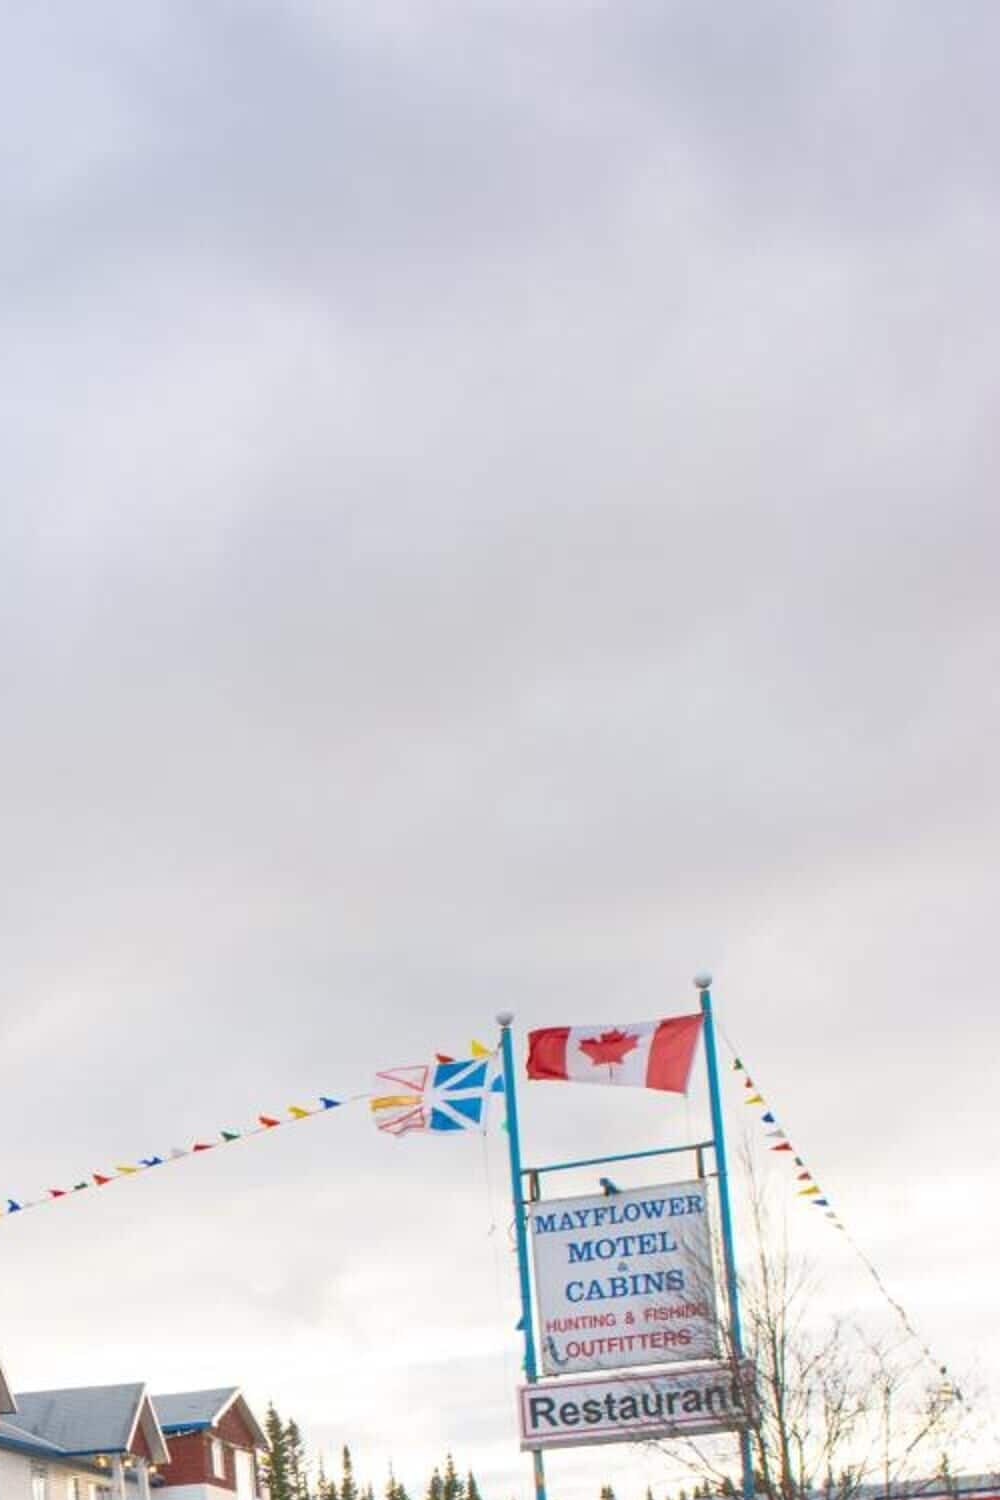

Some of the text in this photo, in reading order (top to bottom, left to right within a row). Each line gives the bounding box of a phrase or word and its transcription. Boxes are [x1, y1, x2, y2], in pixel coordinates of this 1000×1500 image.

[535, 1194, 704, 1234] MAYFLOWER
[567, 1231, 677, 1263] MOTEL
[565, 1270, 685, 1302] CABINS
[546, 1313, 617, 1333] HUNTING
[624, 1311, 635, 1324] &
[566, 1329, 692, 1358] OUTFITTERS
